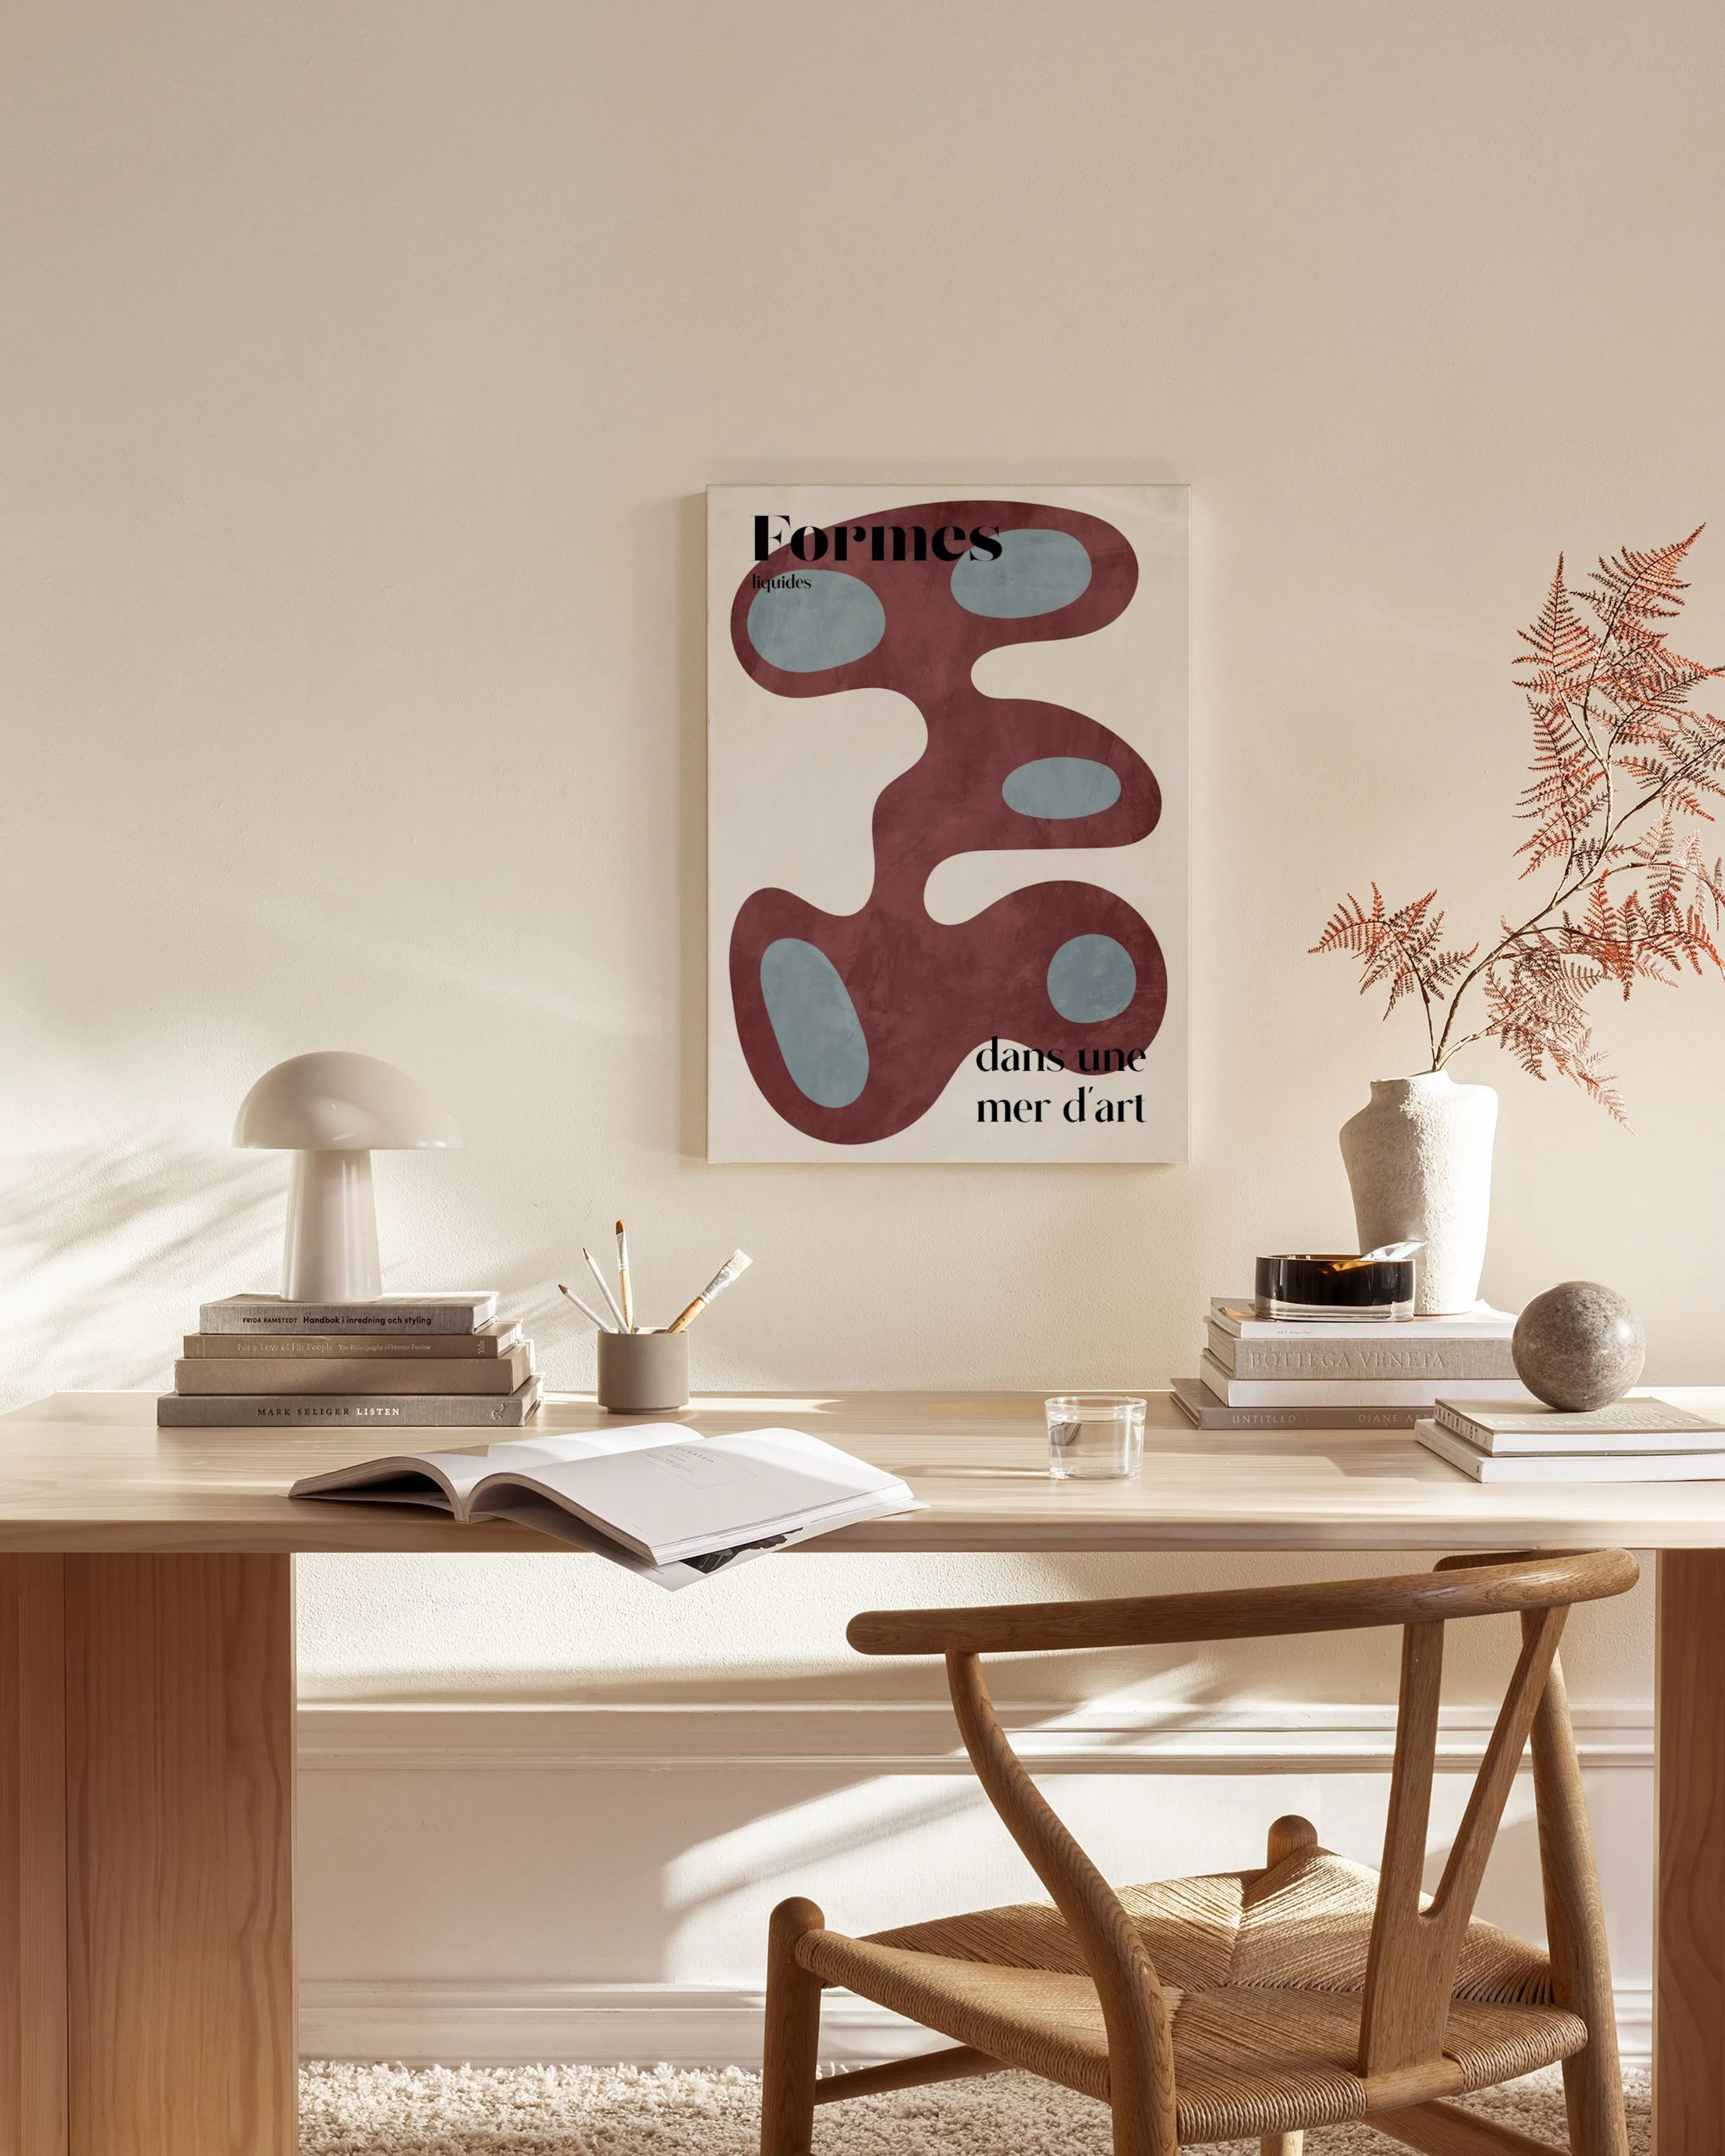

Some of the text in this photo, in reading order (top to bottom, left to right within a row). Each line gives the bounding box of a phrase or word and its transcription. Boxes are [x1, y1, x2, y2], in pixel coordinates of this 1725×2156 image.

[748, 515, 1003, 561] Formes
[752, 574, 812, 592] liquides
[976, 1036, 1146, 1072] dans une
[977, 1086, 1146, 1122] mer d'art
[347, 1317, 385, 1325] inredning
[405, 1317, 431, 1325] styling
[307, 1343, 334, 1353] People
[1250, 1352, 1446, 1368] BOTTEGA VENETA
[1232, 1414, 1296, 1423] UNTITLED
[1358, 1414, 1399, 1423] DIANE
